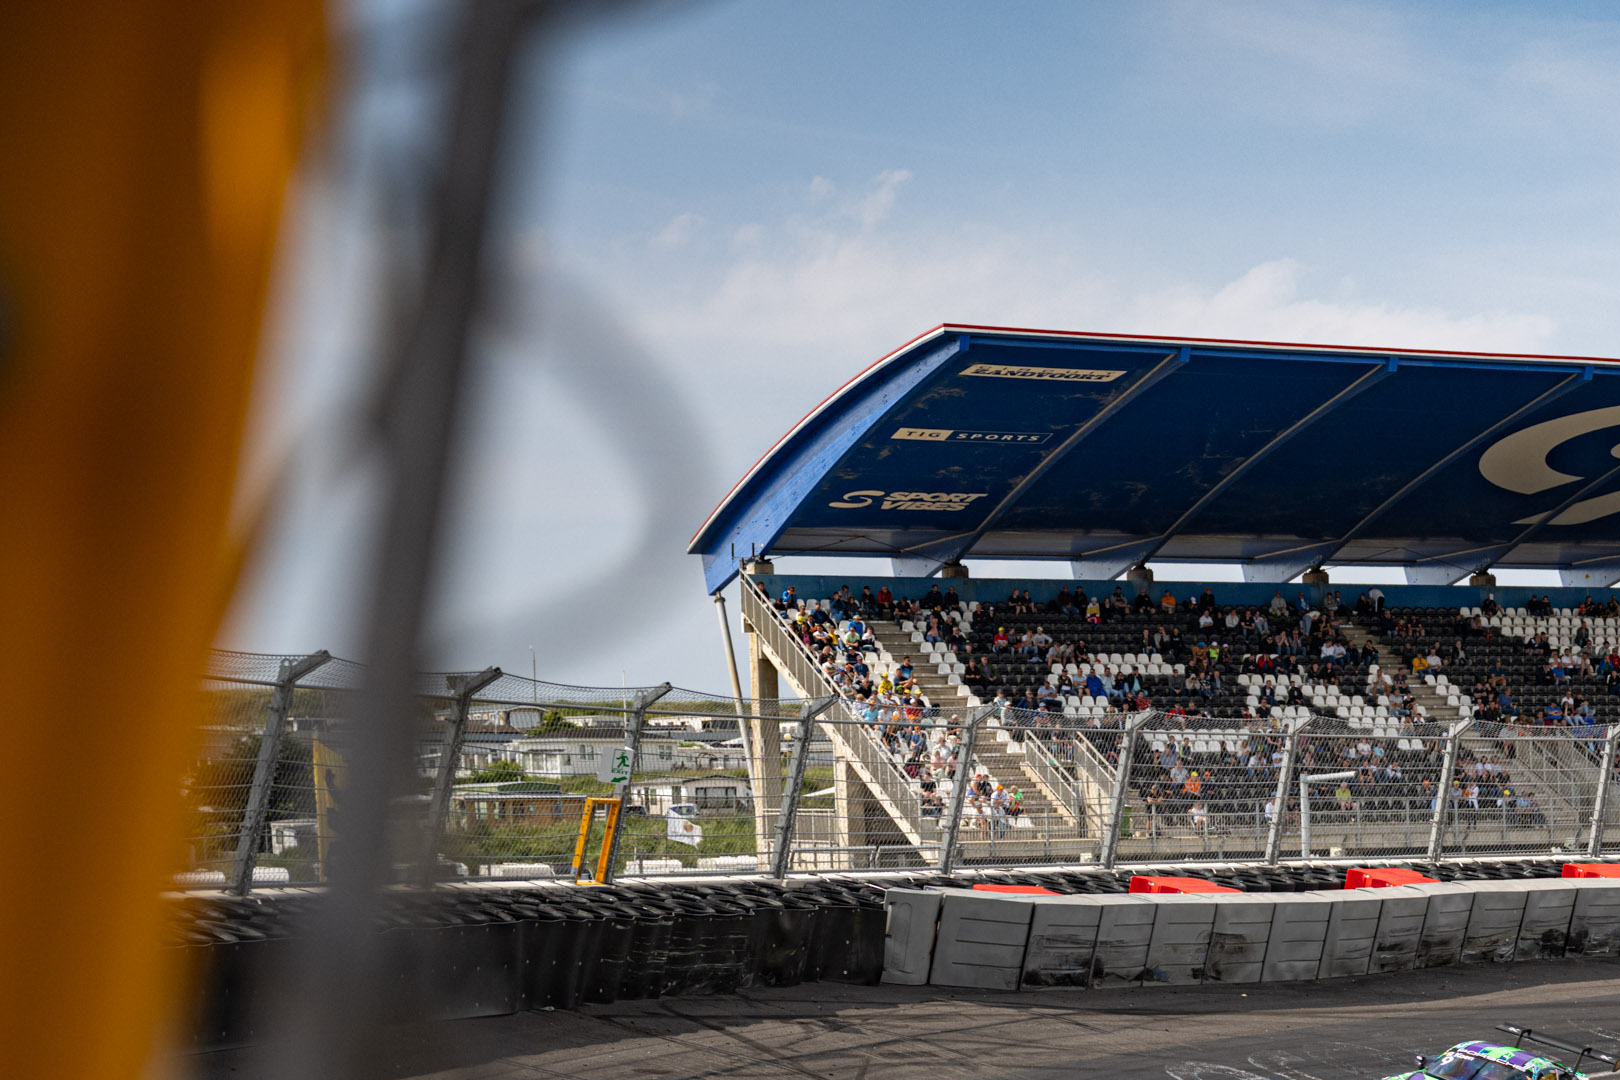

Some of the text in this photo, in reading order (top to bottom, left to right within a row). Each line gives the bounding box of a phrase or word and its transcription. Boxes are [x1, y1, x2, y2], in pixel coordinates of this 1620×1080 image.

[971, 368, 1110, 381] ZANDVOORT
[906, 430, 1041, 442] TIG SPORTS
[883, 491, 988, 503] SPORT
[880, 500, 970, 512] VIBES
[1440, 1056, 1455, 1066] 9
